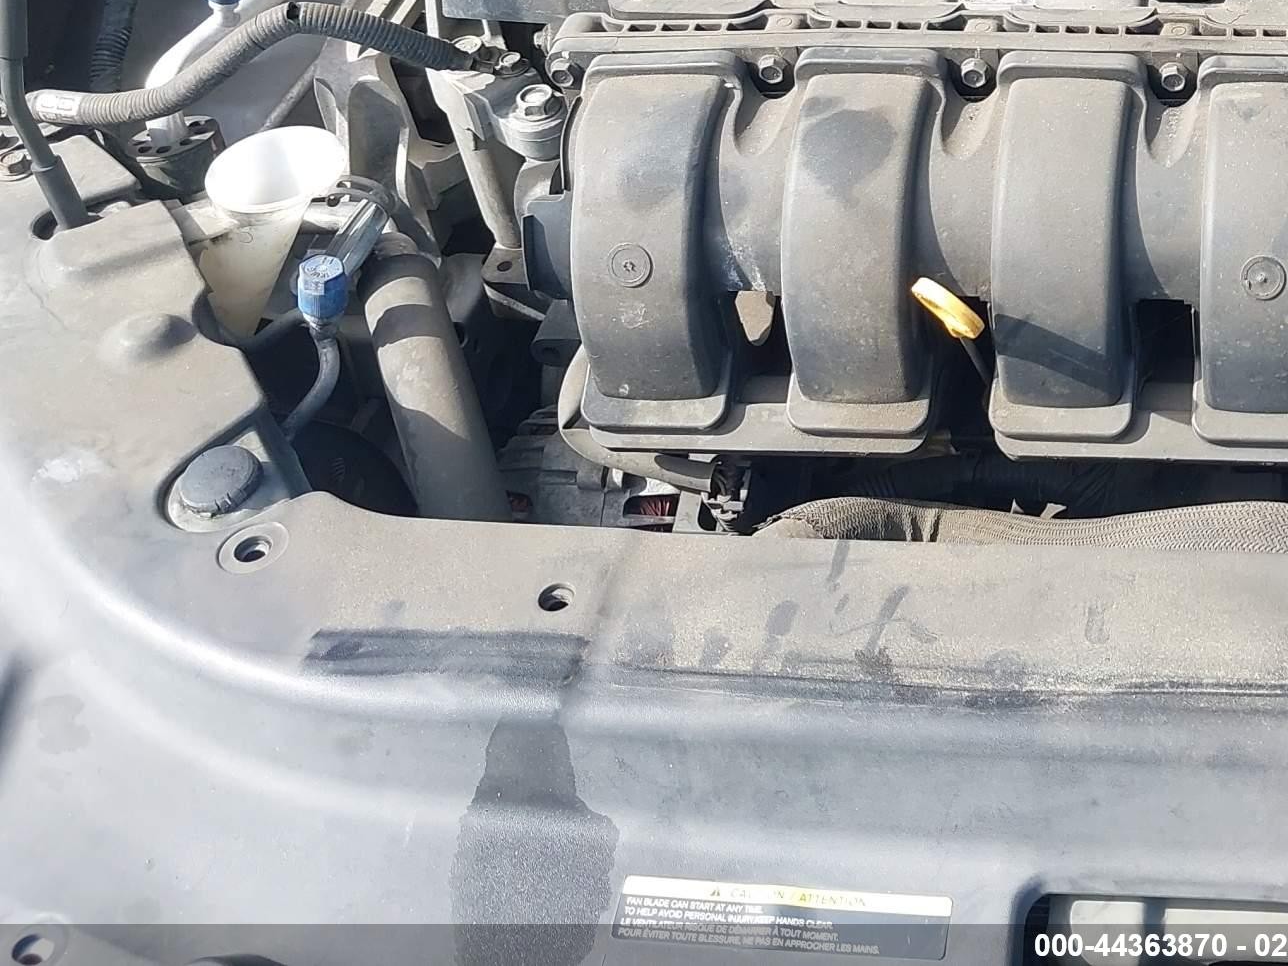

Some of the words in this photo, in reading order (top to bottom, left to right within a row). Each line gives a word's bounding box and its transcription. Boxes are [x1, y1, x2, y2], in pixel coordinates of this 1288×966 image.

[626, 896, 643, 906] FAN
[643, 897, 670, 908] BLADE
[671, 899, 689, 909] CAN
[690, 900, 714, 911] START
[715, 903, 726, 912] AT
[726, 904, 744, 913] ANY
[625, 905, 636, 915] TO
[636, 907, 658, 917] HELP
[658, 909, 683, 919] AVOID
[684, 910, 726, 923] PERSONAL
[776, 916, 805, 927] HANDS
[618, 926, 642, 938] POUR
[671, 931, 697, 942] TOUTE
[754, 936, 771, 946] PAS
[772, 937, 785, 947] EN
[785, 938, 835, 951] APPROCHER
[620, 918, 631, 927] LE
[716, 924, 728, 934] DE
[779, 927, 802, 938] TOUT
